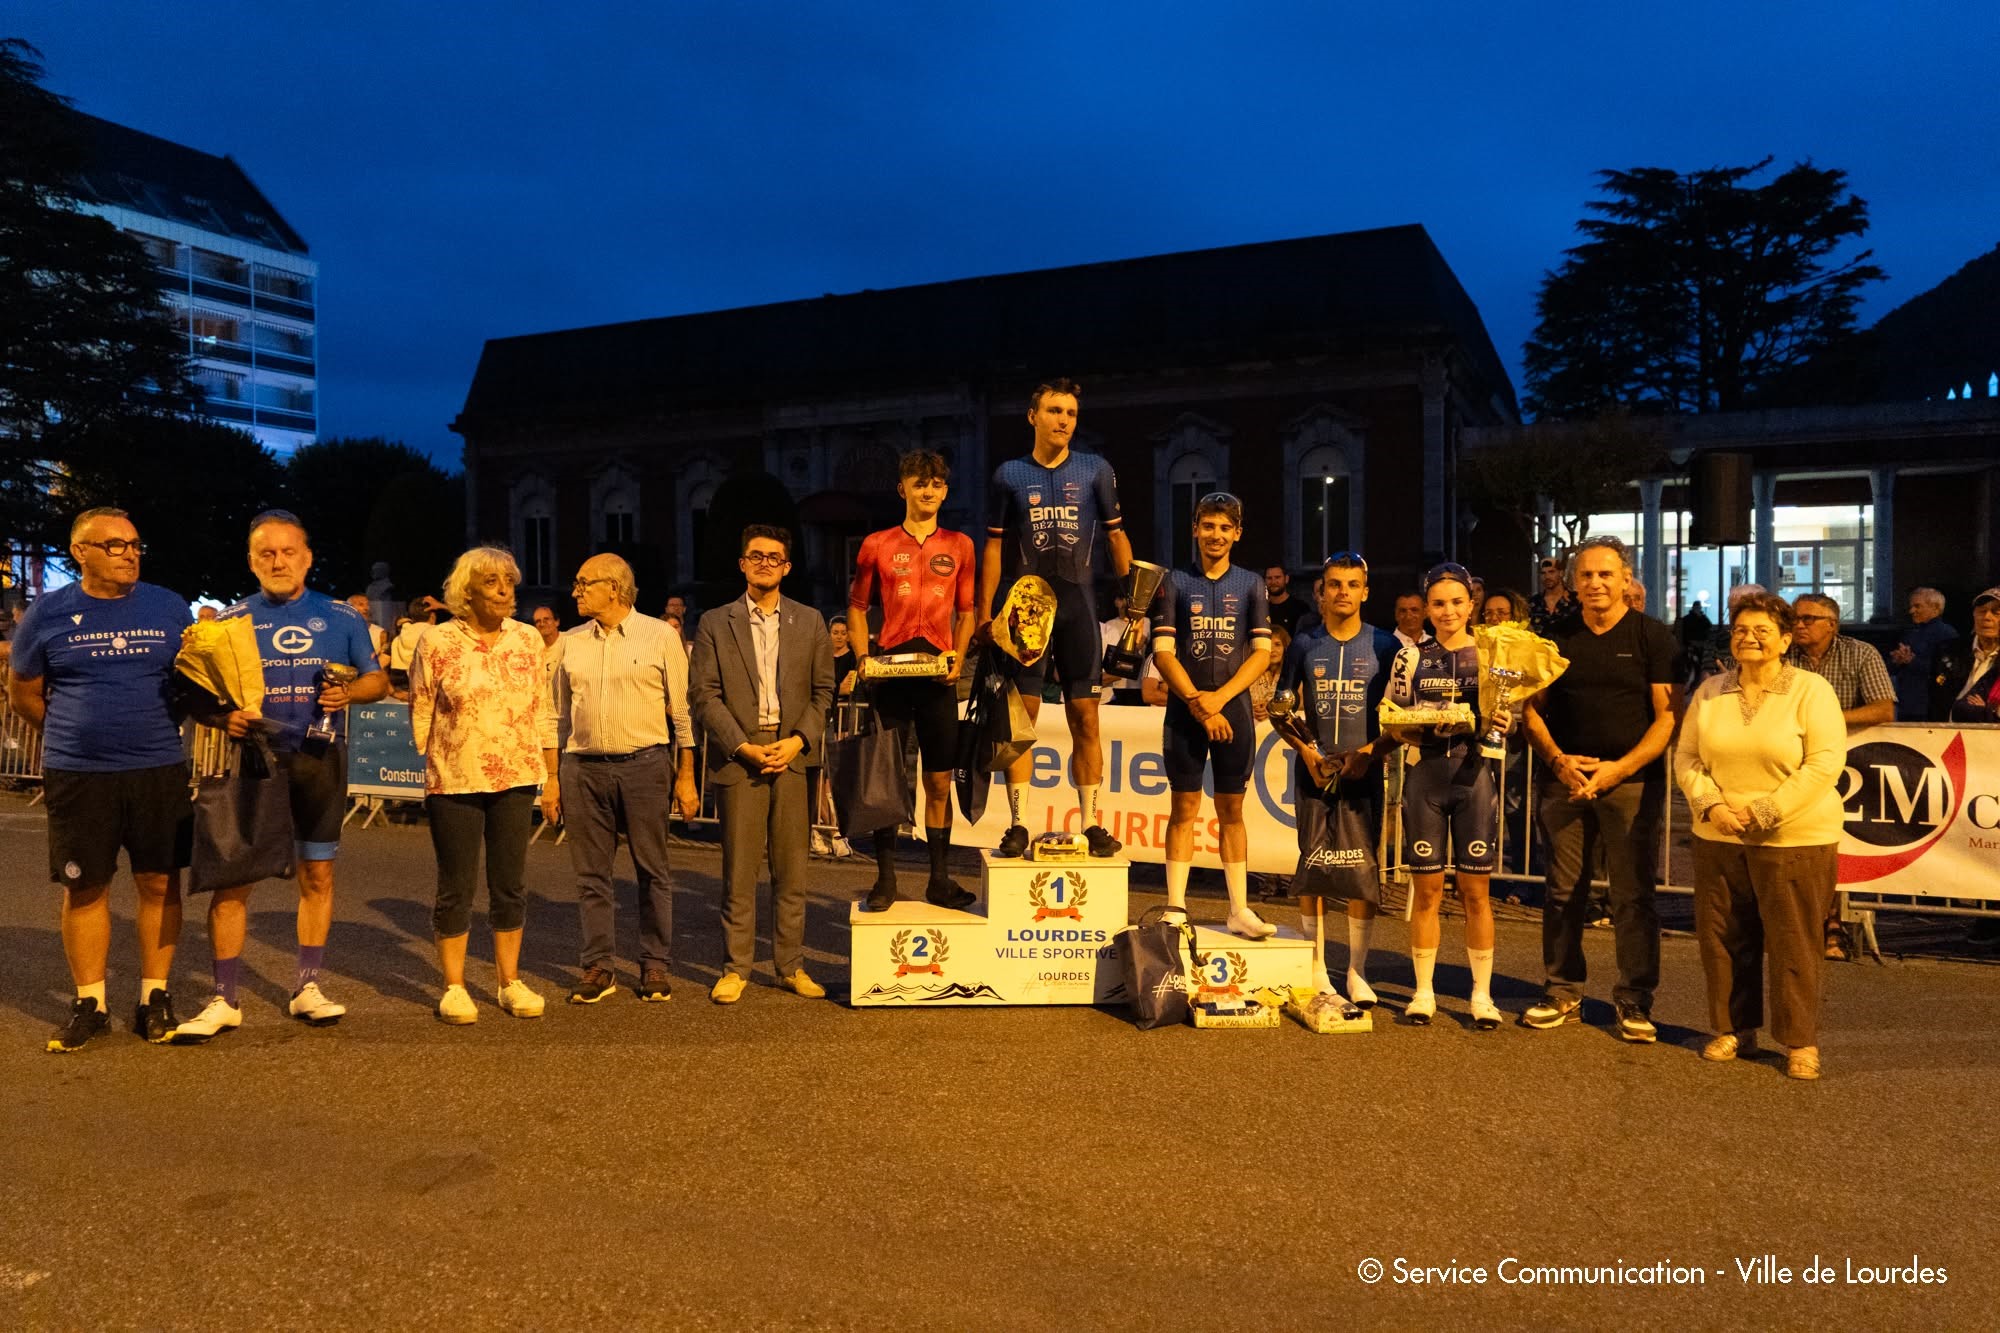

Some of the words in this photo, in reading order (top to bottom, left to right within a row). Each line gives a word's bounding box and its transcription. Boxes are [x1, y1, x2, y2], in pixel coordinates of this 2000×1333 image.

[1029, 506, 1078, 522] BMC
[1032, 521, 1079, 531] BÉZIERS
[1190, 616, 1236, 631] BMC
[68, 631, 115, 643] LOURDES
[117, 628, 166, 638] PYRÉNÉES
[1192, 631, 1235, 640] BÉZIERS
[91, 647, 150, 657] CYCLISME
[261, 656, 329, 668] Groupam
[265, 684, 315, 695] Leclerc
[1316, 679, 1366, 692] BMC
[269, 694, 309, 703] LOURDES
[1317, 693, 1364, 701] BÉZIERS
[360, 710, 377, 720] CIC
[1320, 849, 1364, 860] LOURDES
[1050, 877, 1064, 903] 1
[1007, 929, 1107, 942] LOURDES
[912, 935, 928, 957] 2
[995, 948, 1038, 959] VILLE
[1042, 948, 1119, 960] SPORTIVE
[1038, 972, 1090, 981] LOURDES
[1211, 957, 1229, 984] 3
